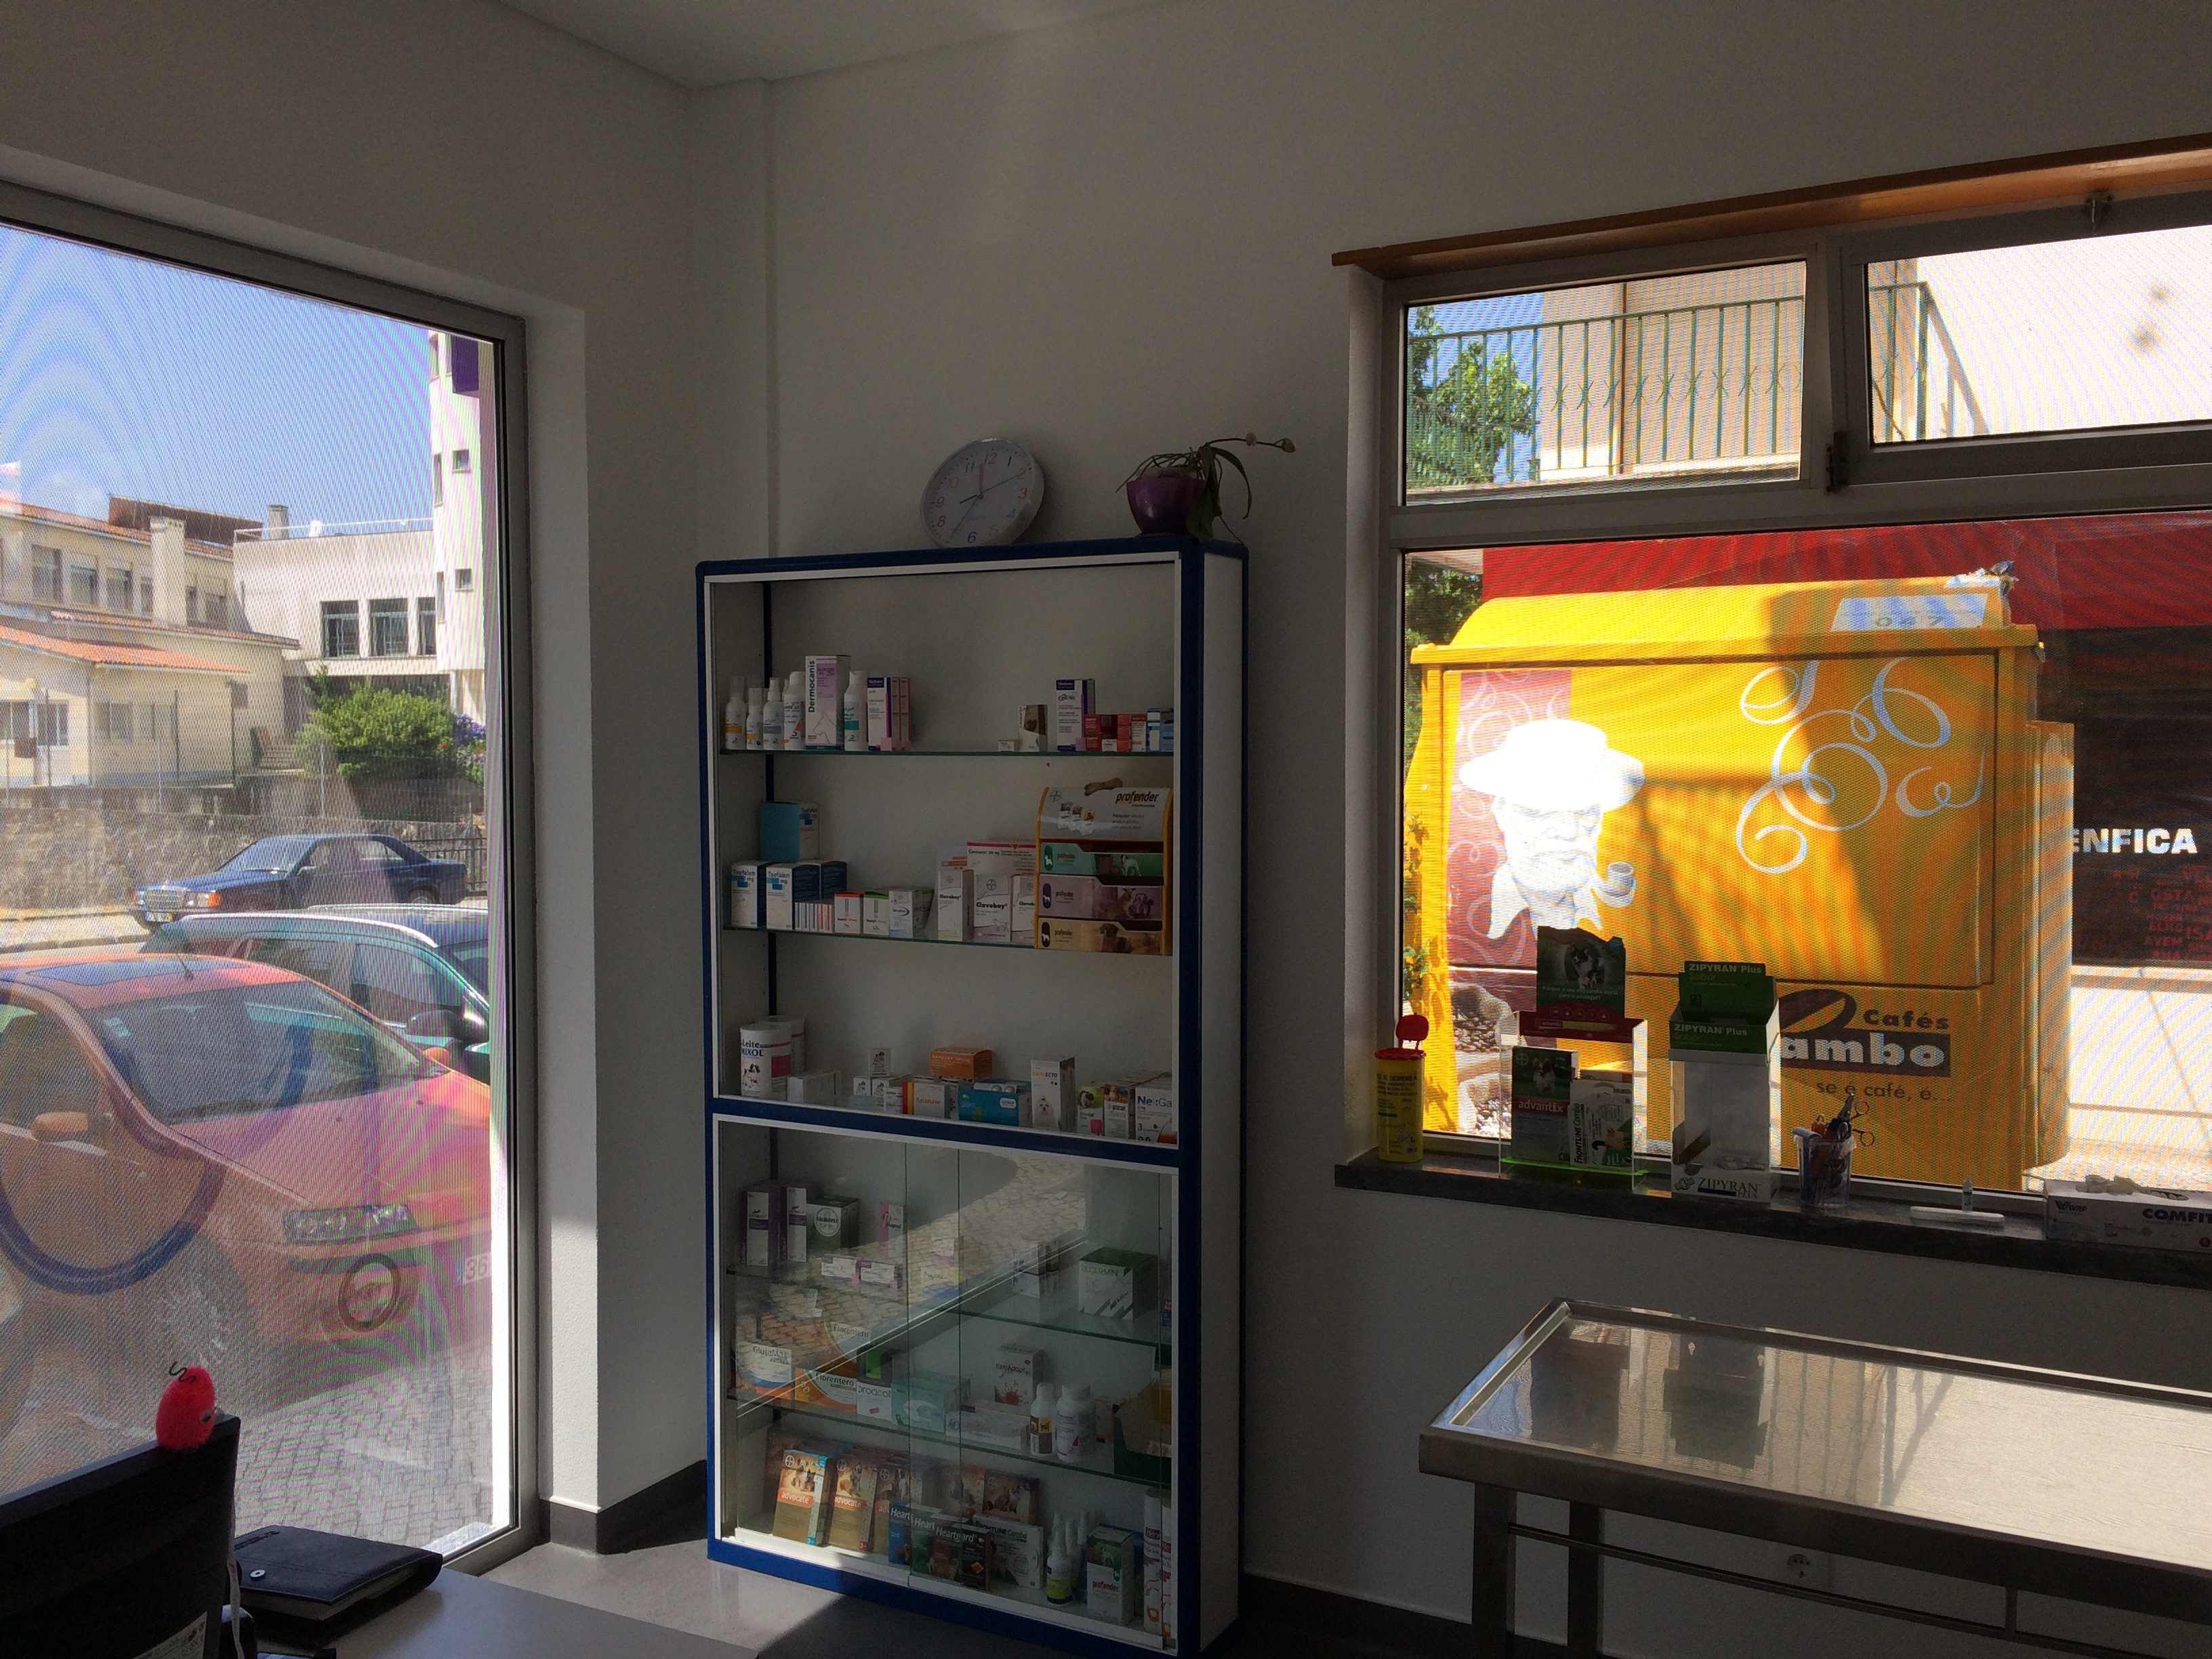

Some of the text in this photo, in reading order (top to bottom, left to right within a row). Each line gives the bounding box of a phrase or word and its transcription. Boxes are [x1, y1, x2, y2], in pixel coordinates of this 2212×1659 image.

[984, 452, 998, 465] 12
[1018, 487, 1028, 499] 3
[936, 496, 945, 508] 9
[937, 515, 947, 527] 8
[967, 531, 977, 544] 6
[1115, 791, 1160, 804] profender
[767, 871, 790, 879] Tsefalen
[976, 901, 1006, 910] Clavobay
[1689, 963, 1762, 974] ZIPYRAN Plus
[1864, 1009, 1950, 1030] Cafés
[1674, 1024, 1748, 1036] ZIPYRAN Plus
[742, 1039, 760, 1048] Leite
[1518, 1100, 1564, 1113] advantix
[1572, 1103, 1583, 1164] FRONTLINE Combo
[1698, 1177, 1758, 1193] ZIPYRAN
[1082, 1265, 1118, 1277] ULCERMIN
[781, 1492, 809, 1504] advocate
